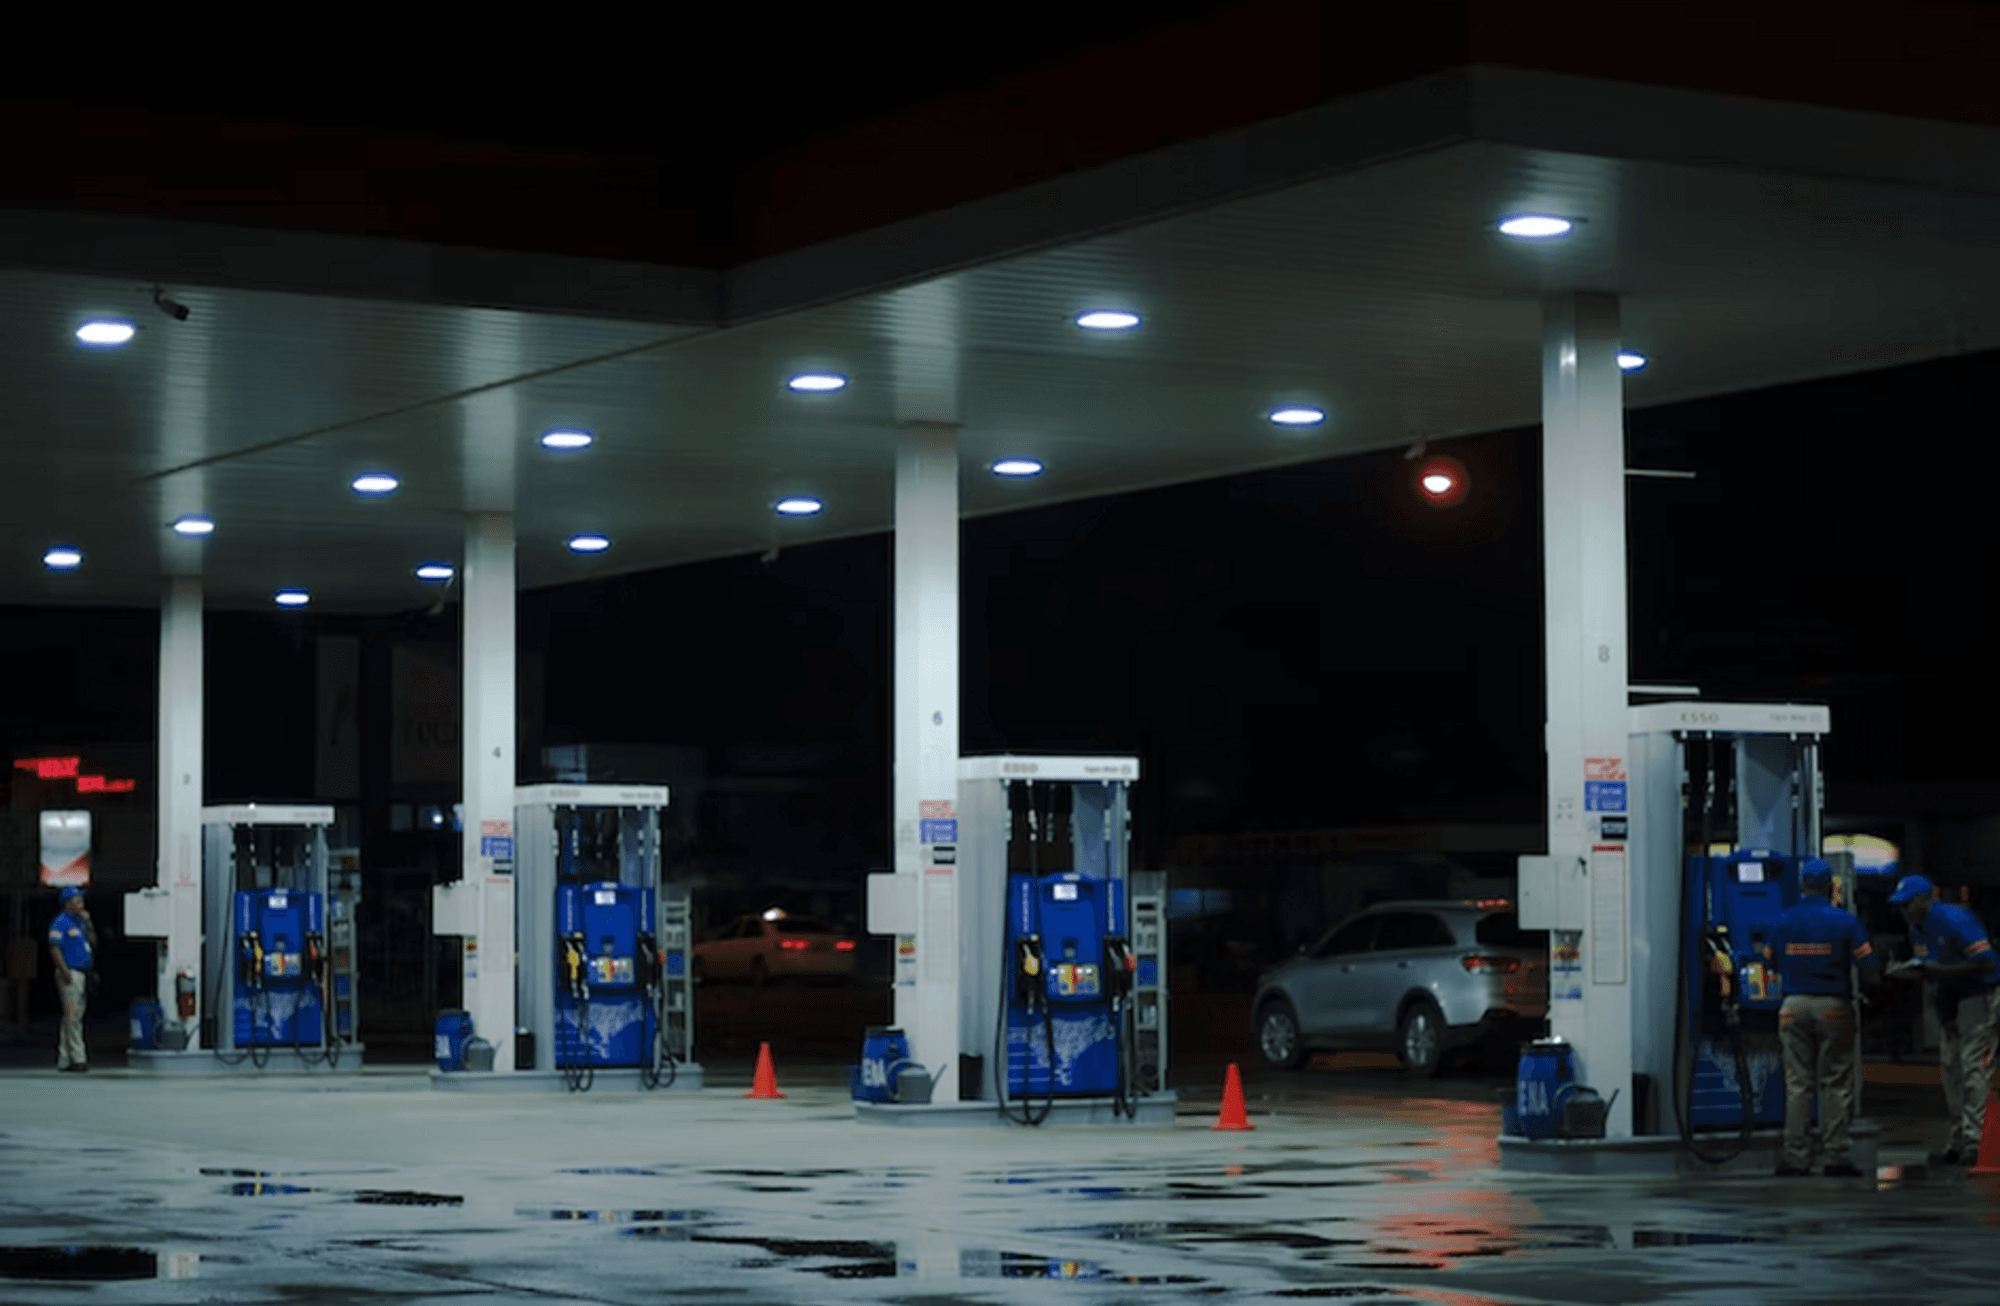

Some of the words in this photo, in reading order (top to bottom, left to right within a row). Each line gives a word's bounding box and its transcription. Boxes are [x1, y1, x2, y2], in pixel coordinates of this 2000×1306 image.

[1598, 645, 1610, 663] 8
[931, 709, 943, 727] 6
[1680, 711, 1719, 725] ESSO
[492, 746, 502, 759] 4
